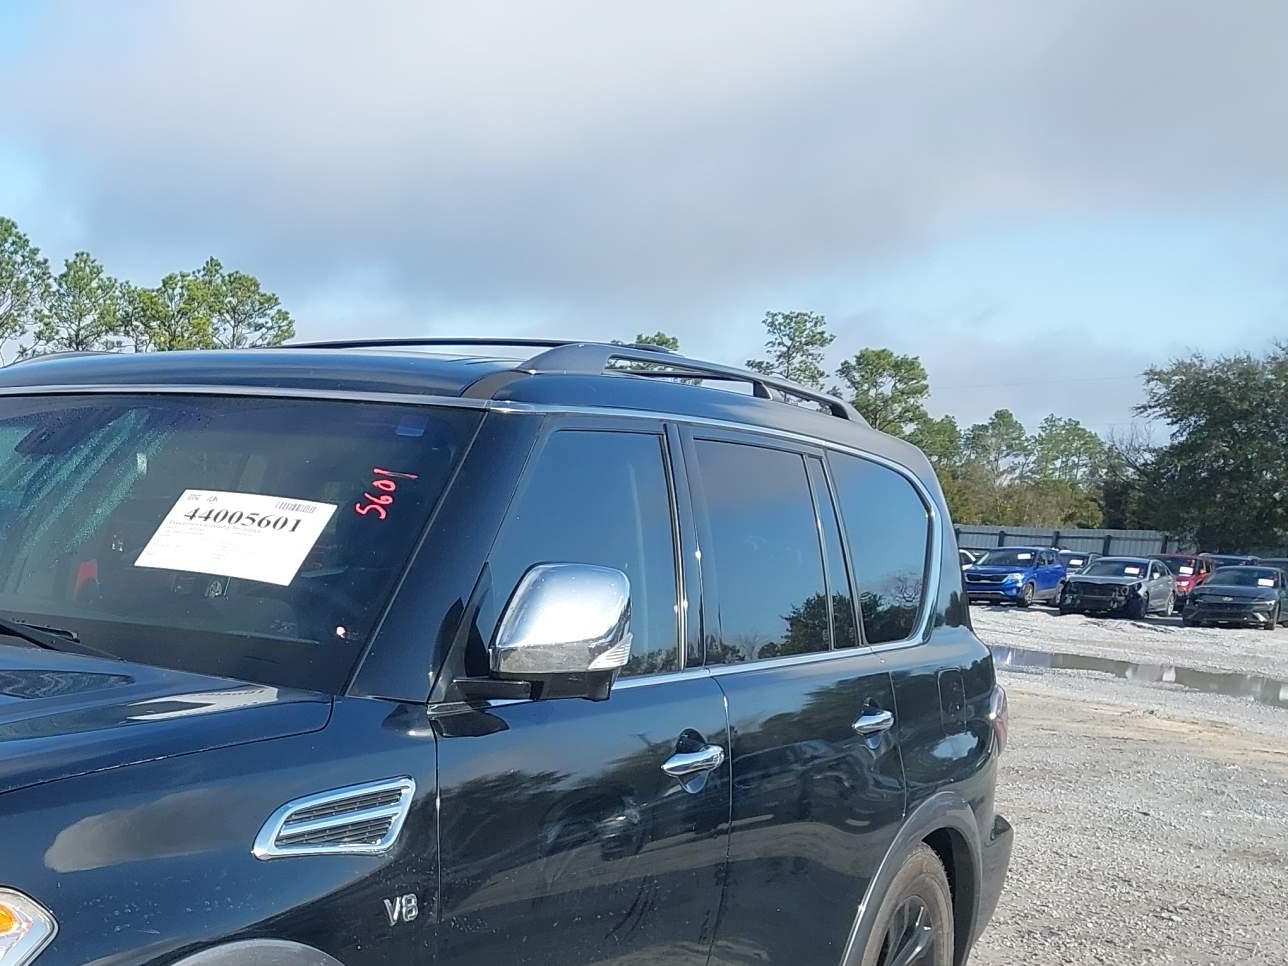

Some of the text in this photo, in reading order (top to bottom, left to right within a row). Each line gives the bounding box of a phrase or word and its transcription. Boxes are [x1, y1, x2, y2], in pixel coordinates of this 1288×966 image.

[355, 467, 420, 520] 5601
[184, 507, 303, 533] 44005601
[383, 893, 419, 927] V8
